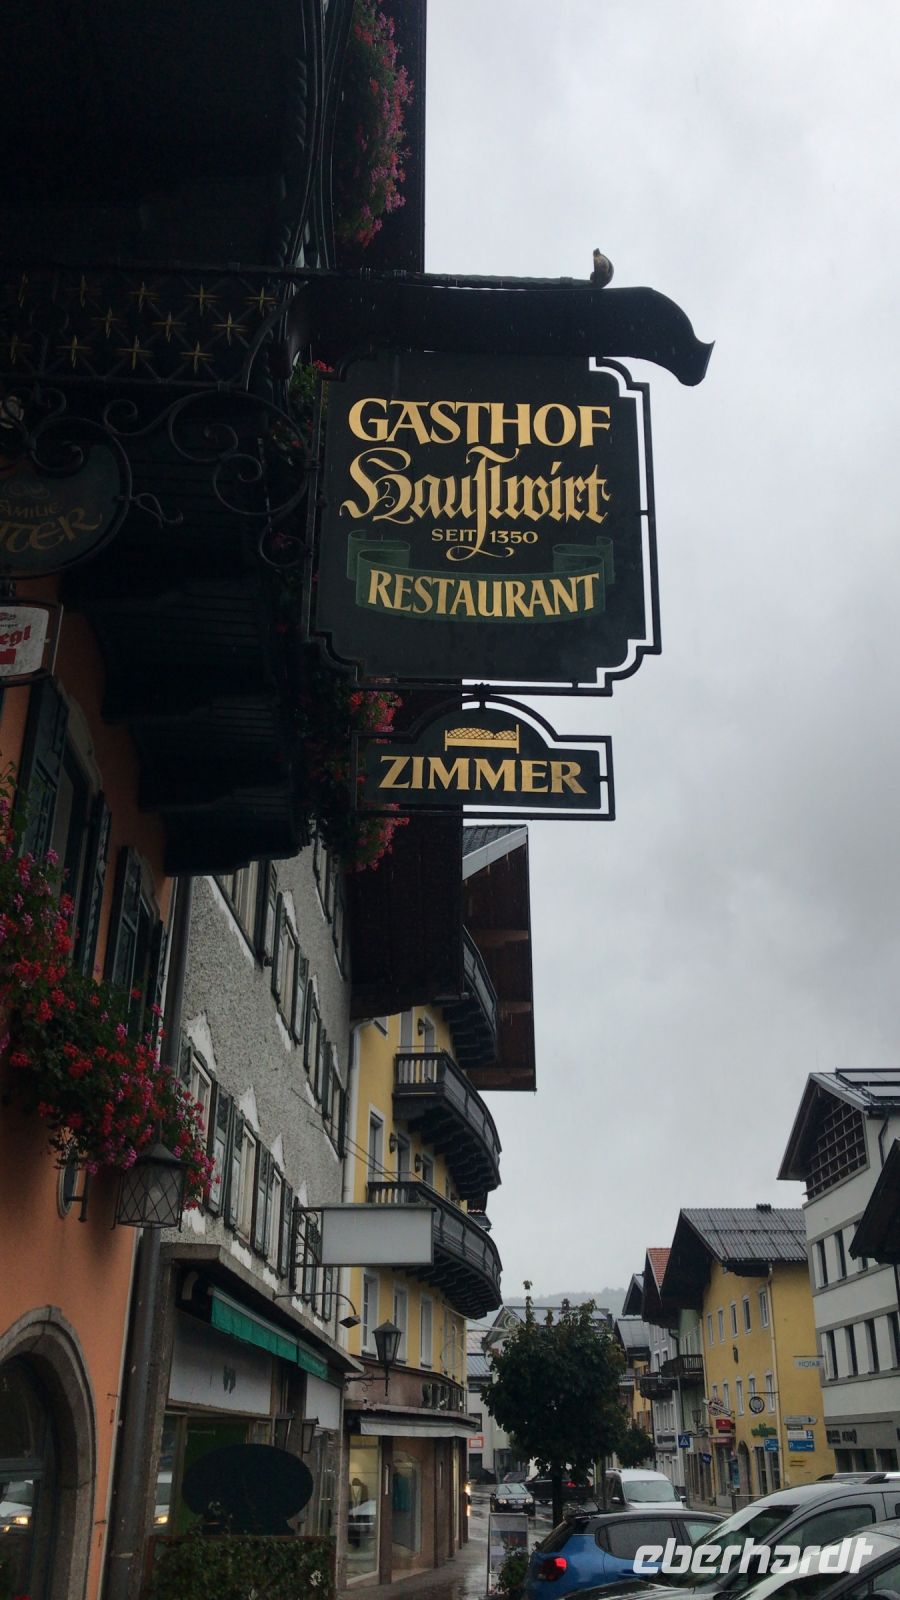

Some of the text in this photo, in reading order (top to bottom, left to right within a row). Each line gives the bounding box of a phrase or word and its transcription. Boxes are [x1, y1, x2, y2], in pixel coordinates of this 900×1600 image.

[347, 397, 612, 448] GASTHOF
[430, 529, 539, 545] SEIT 1350
[368, 568, 600, 619] RESTAURANT
[0, 624, 32, 647] egl
[379, 755, 588, 795] ZIMMER
